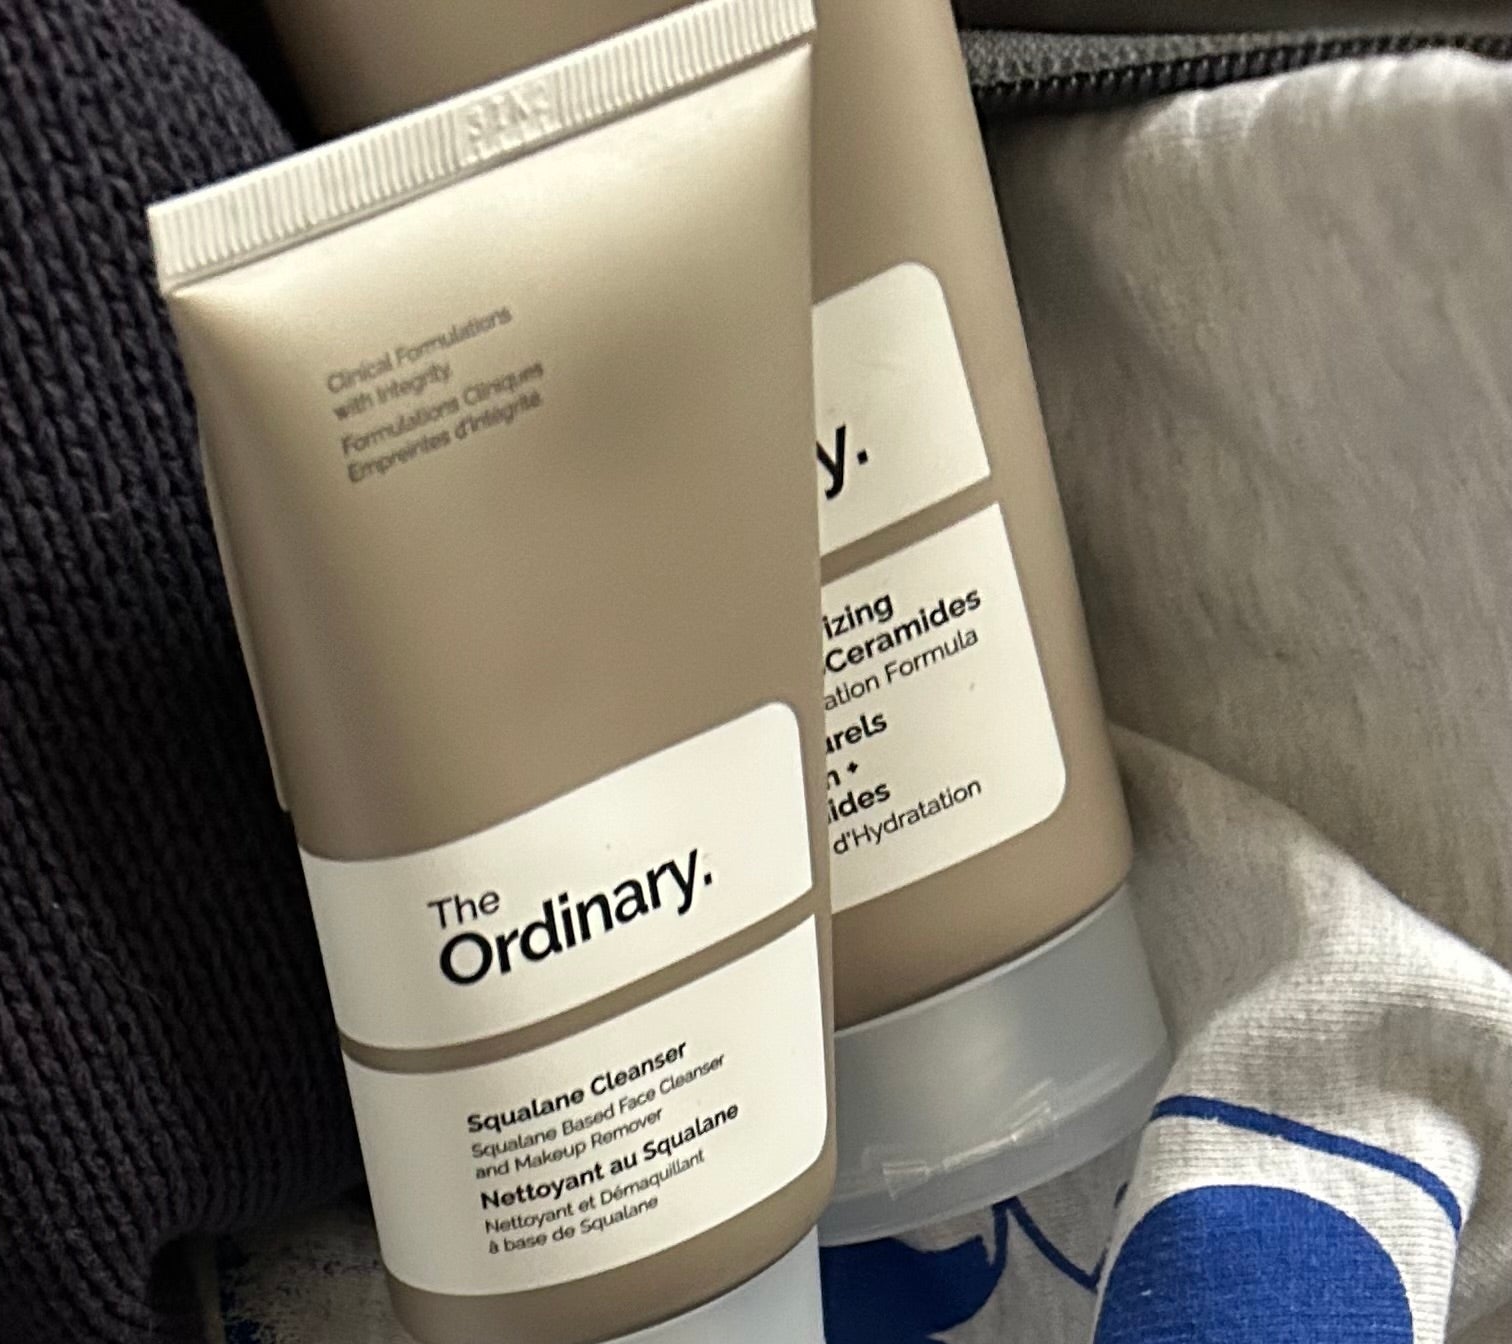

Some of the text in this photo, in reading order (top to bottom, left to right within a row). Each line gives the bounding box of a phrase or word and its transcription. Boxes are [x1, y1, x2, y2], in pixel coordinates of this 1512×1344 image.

[327, 306, 512, 393] Clinical Formulations
[333, 392, 374, 421] with
[341, 361, 544, 455] Formulations Cliniques
[347, 430, 452, 483] Empreintes
[823, 589, 981, 675] Ceramides
[885, 628, 979, 684] Formula
[833, 779, 982, 855] d'Hydratation
[428, 890, 501, 931] The
[439, 847, 714, 987] Ordinary.
[467, 1041, 687, 1134] Squalane Cleanser
[471, 1054, 725, 1159] Squalane Based Face Cleanser
[476, 1107, 663, 1180] and Makeup Remover
[480, 1104, 740, 1210] Nettoyant au Squalane
[485, 1149, 706, 1234] Nettoyant et Démaquillant
[489, 1196, 659, 1255] à base de Squalane
